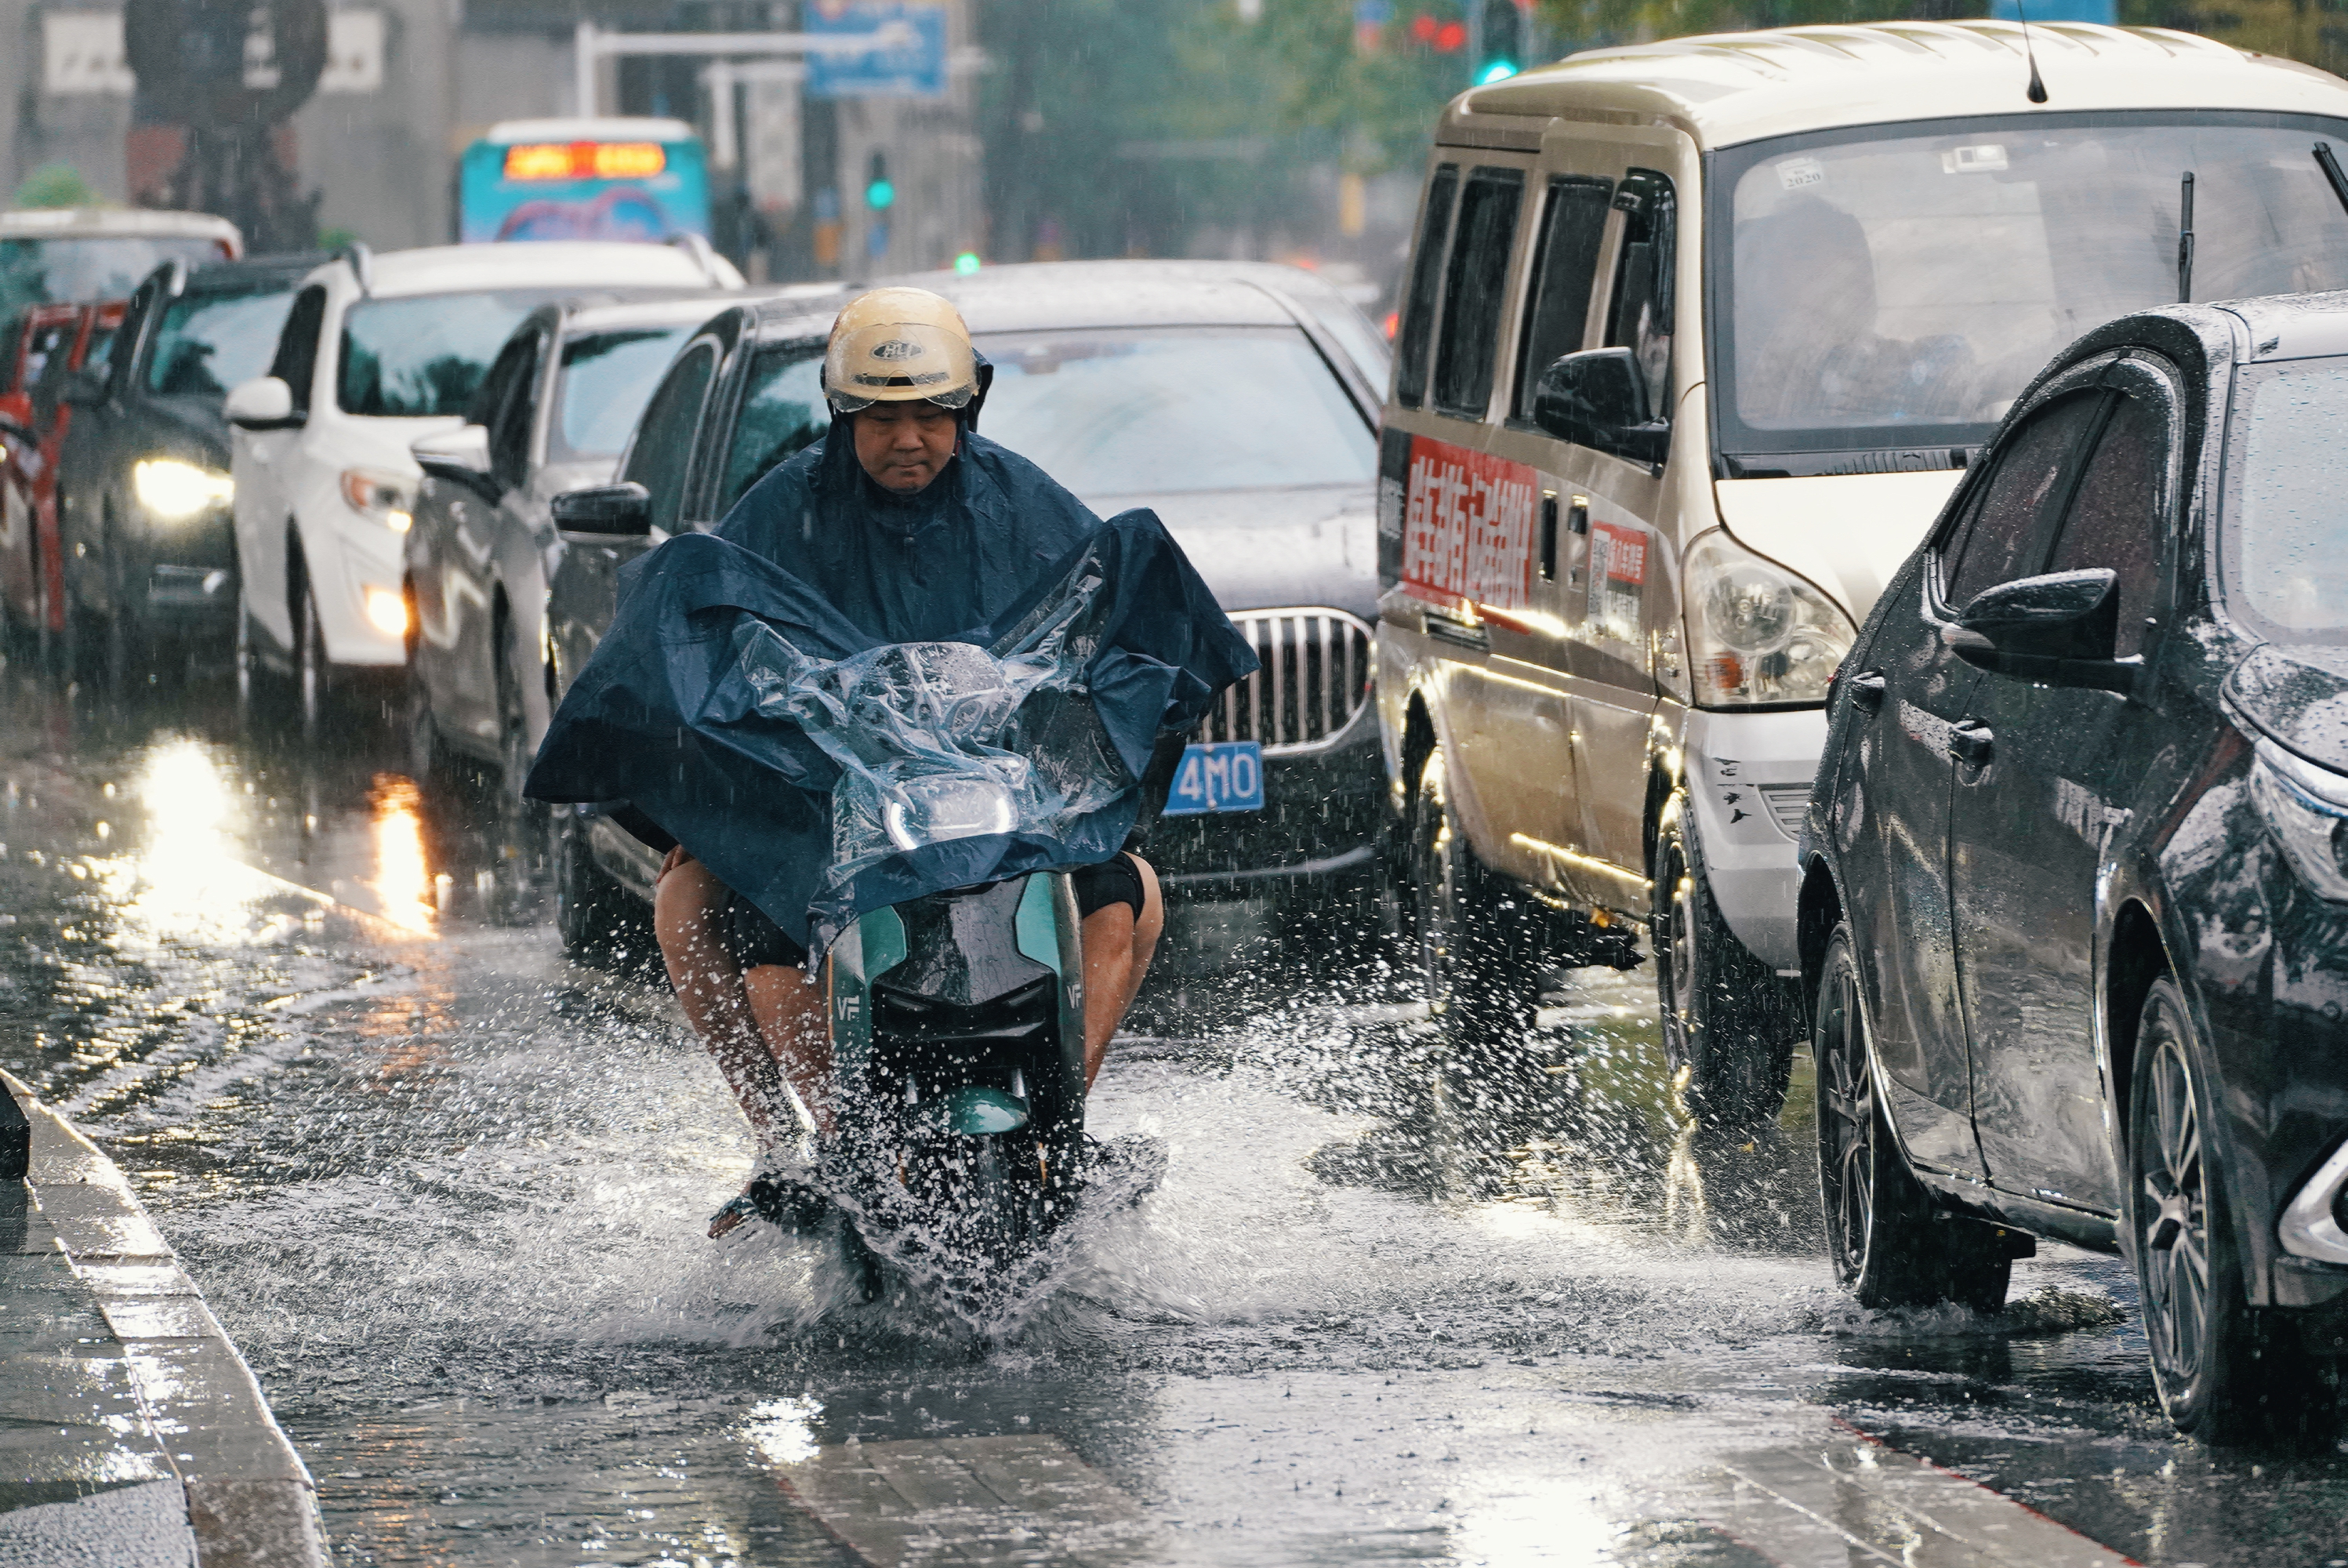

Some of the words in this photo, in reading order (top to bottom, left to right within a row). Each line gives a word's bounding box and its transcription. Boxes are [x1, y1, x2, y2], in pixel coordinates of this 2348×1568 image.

[1787, 172, 1820, 187] 2020
[836, 995, 860, 1021] VF
[1066, 982, 1081, 1009] VF
